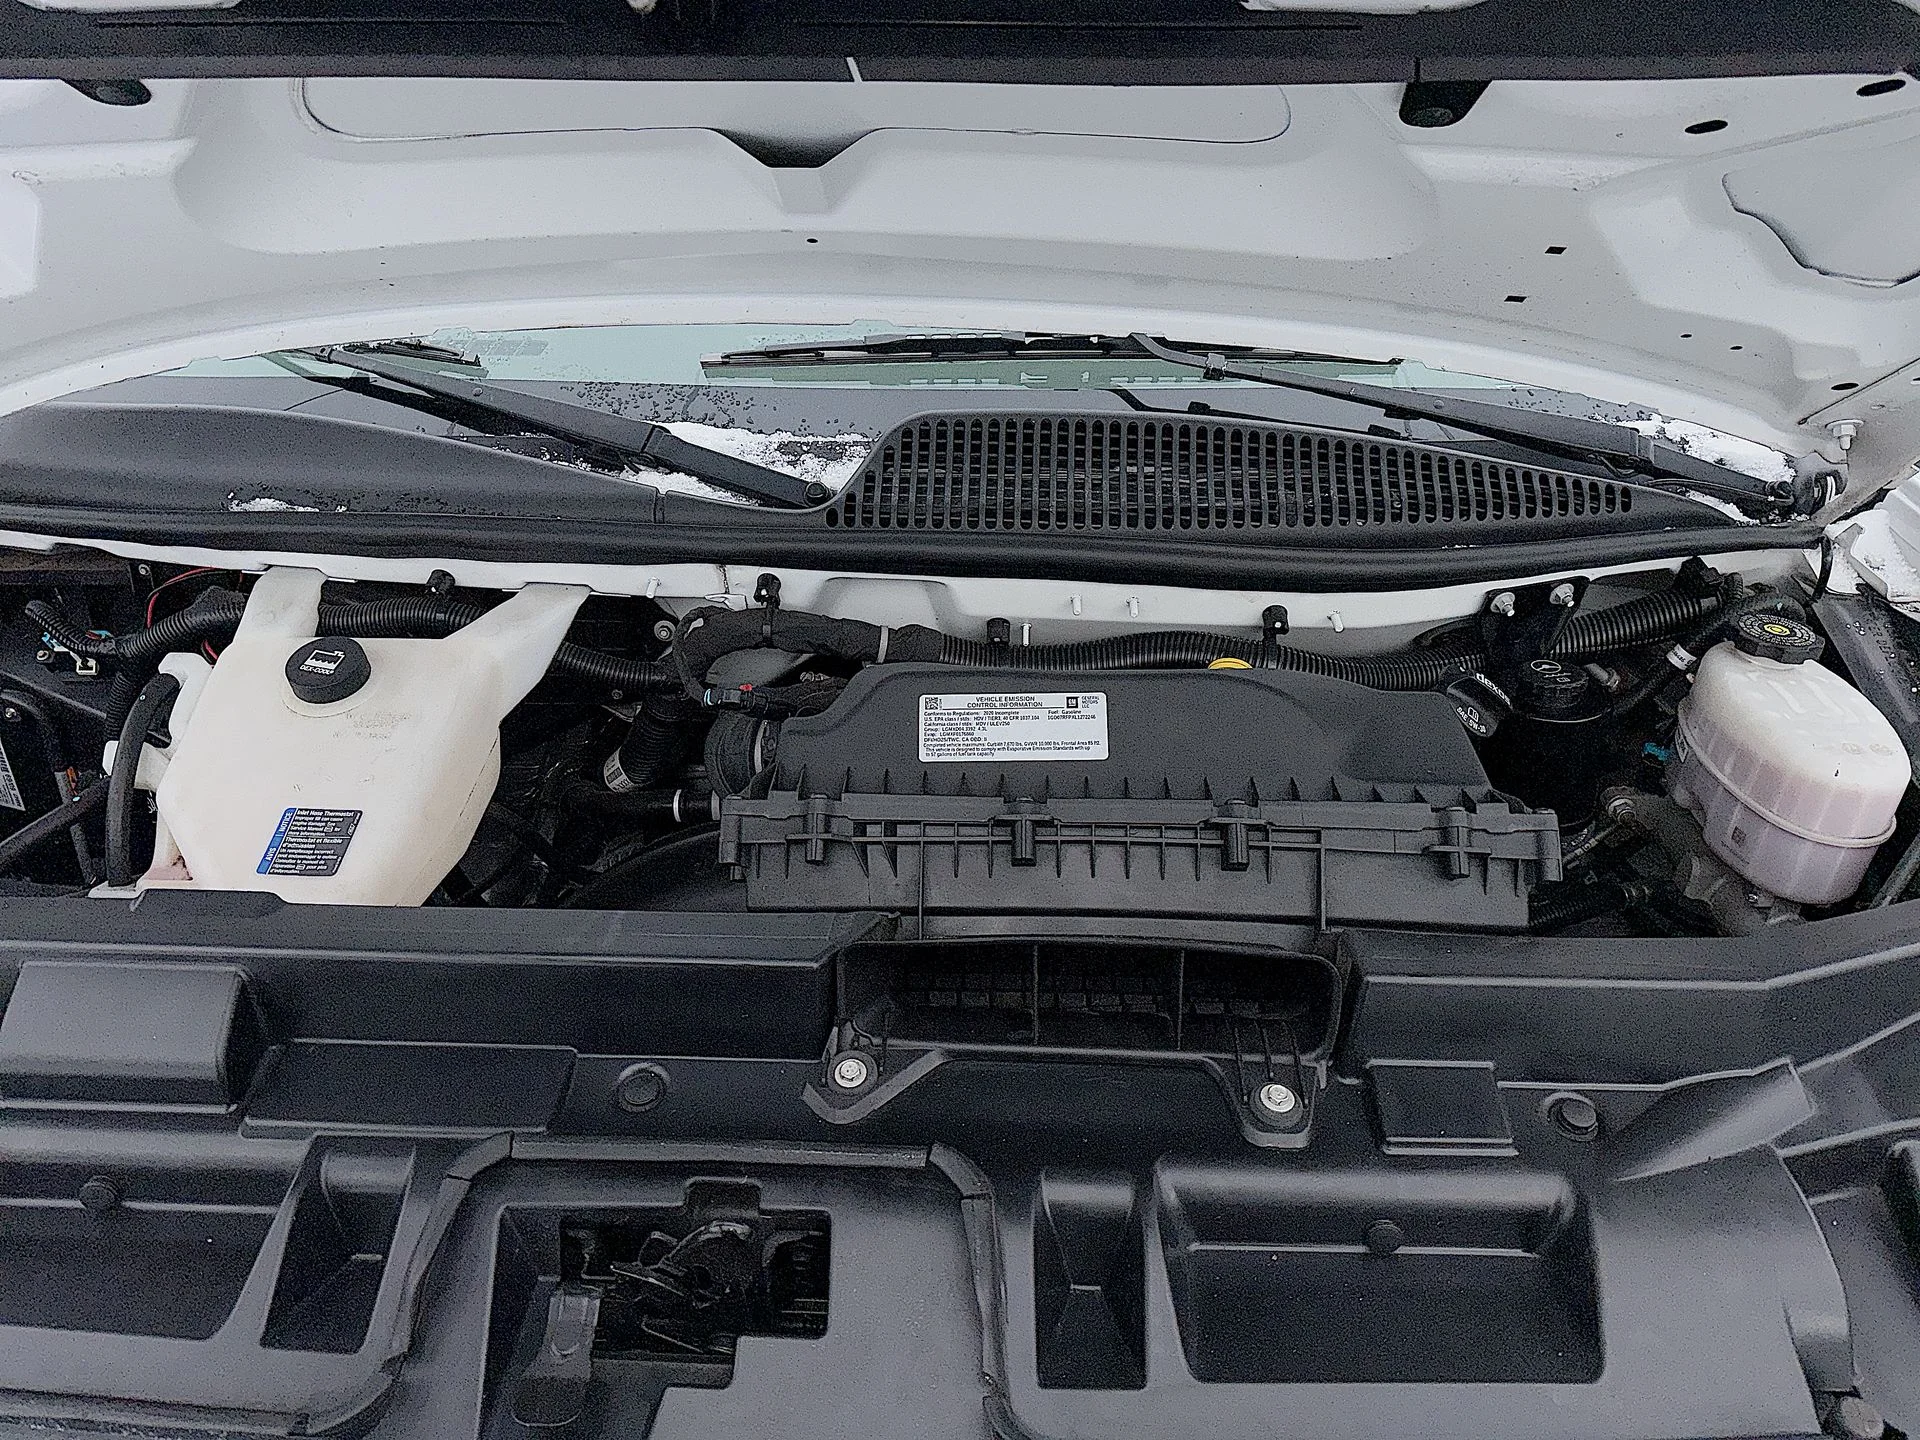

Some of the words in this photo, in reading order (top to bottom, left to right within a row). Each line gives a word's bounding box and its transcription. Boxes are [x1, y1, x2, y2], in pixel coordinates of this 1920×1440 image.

[1476, 672, 1511, 706] dexos
[1456, 706, 1468, 721] SAE
[278, 812, 293, 832] NOTICE
[265, 847, 277, 860] AVIS
